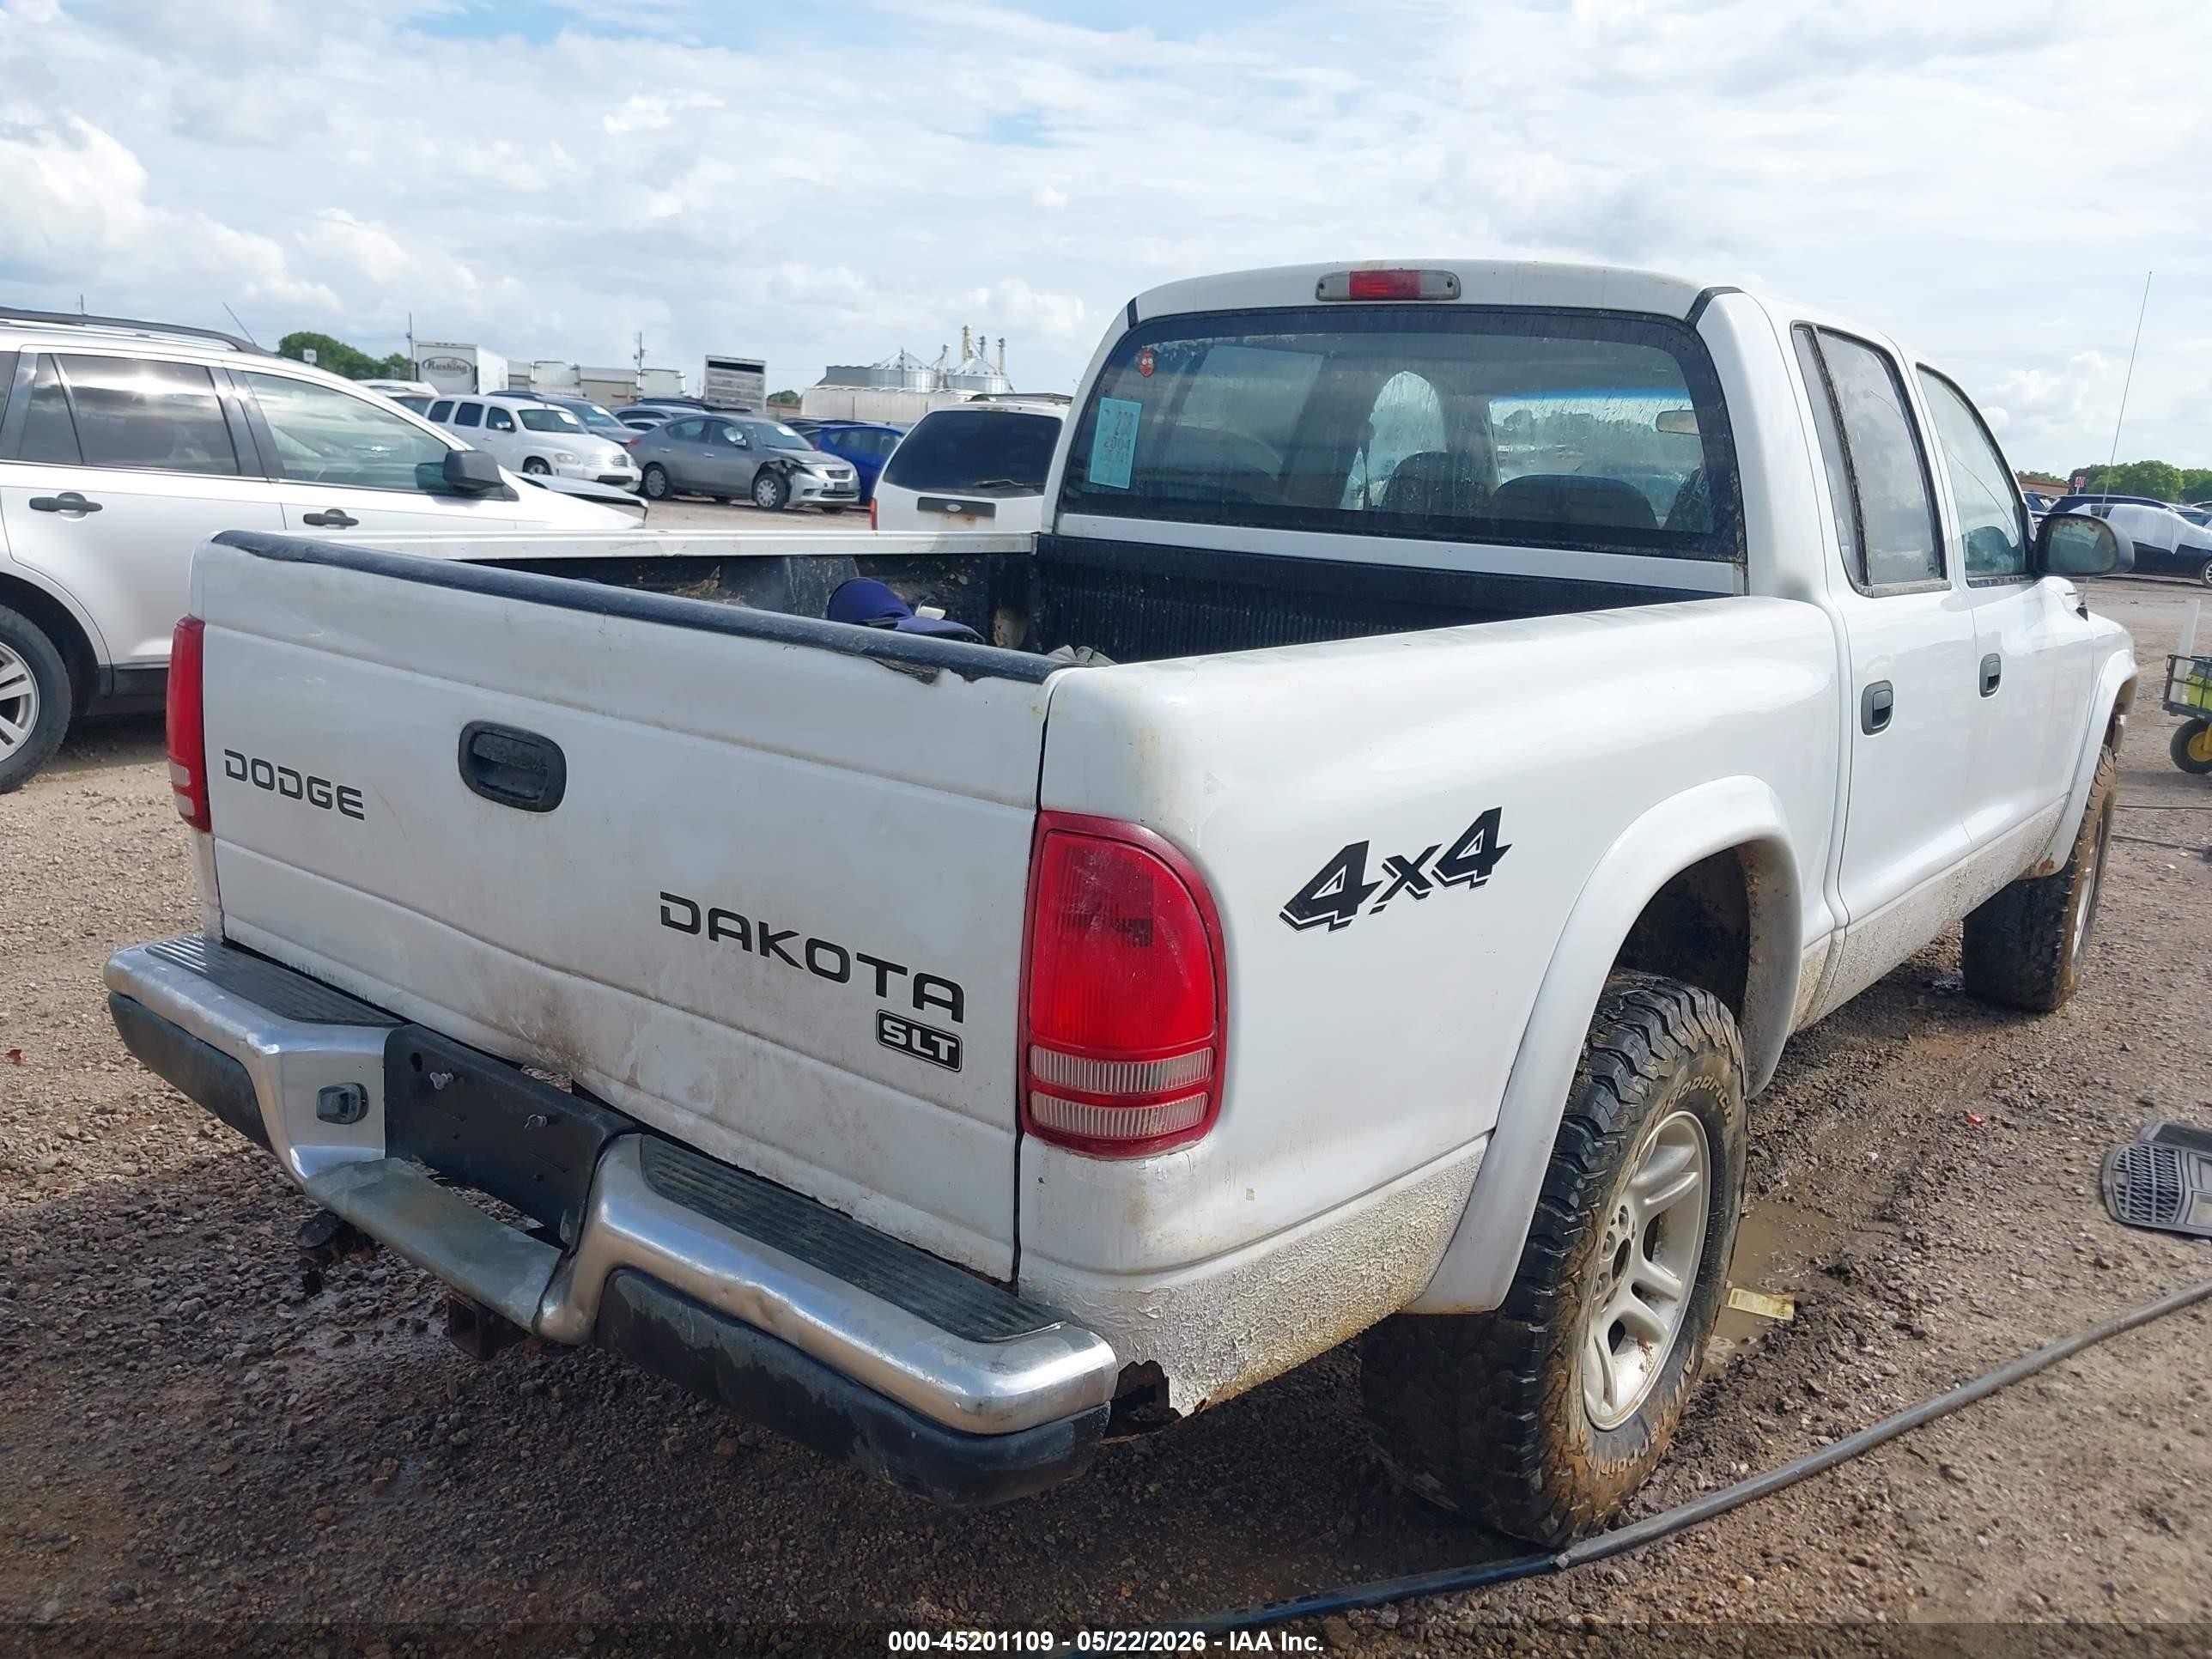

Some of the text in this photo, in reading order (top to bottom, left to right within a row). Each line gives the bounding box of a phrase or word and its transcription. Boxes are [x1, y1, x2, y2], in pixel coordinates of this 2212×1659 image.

[225, 749, 365, 821] DODGE
[1278, 806, 1512, 933] 4x4
[659, 890, 965, 1023] DAKOTA
[882, 1018, 958, 1063] SLT
